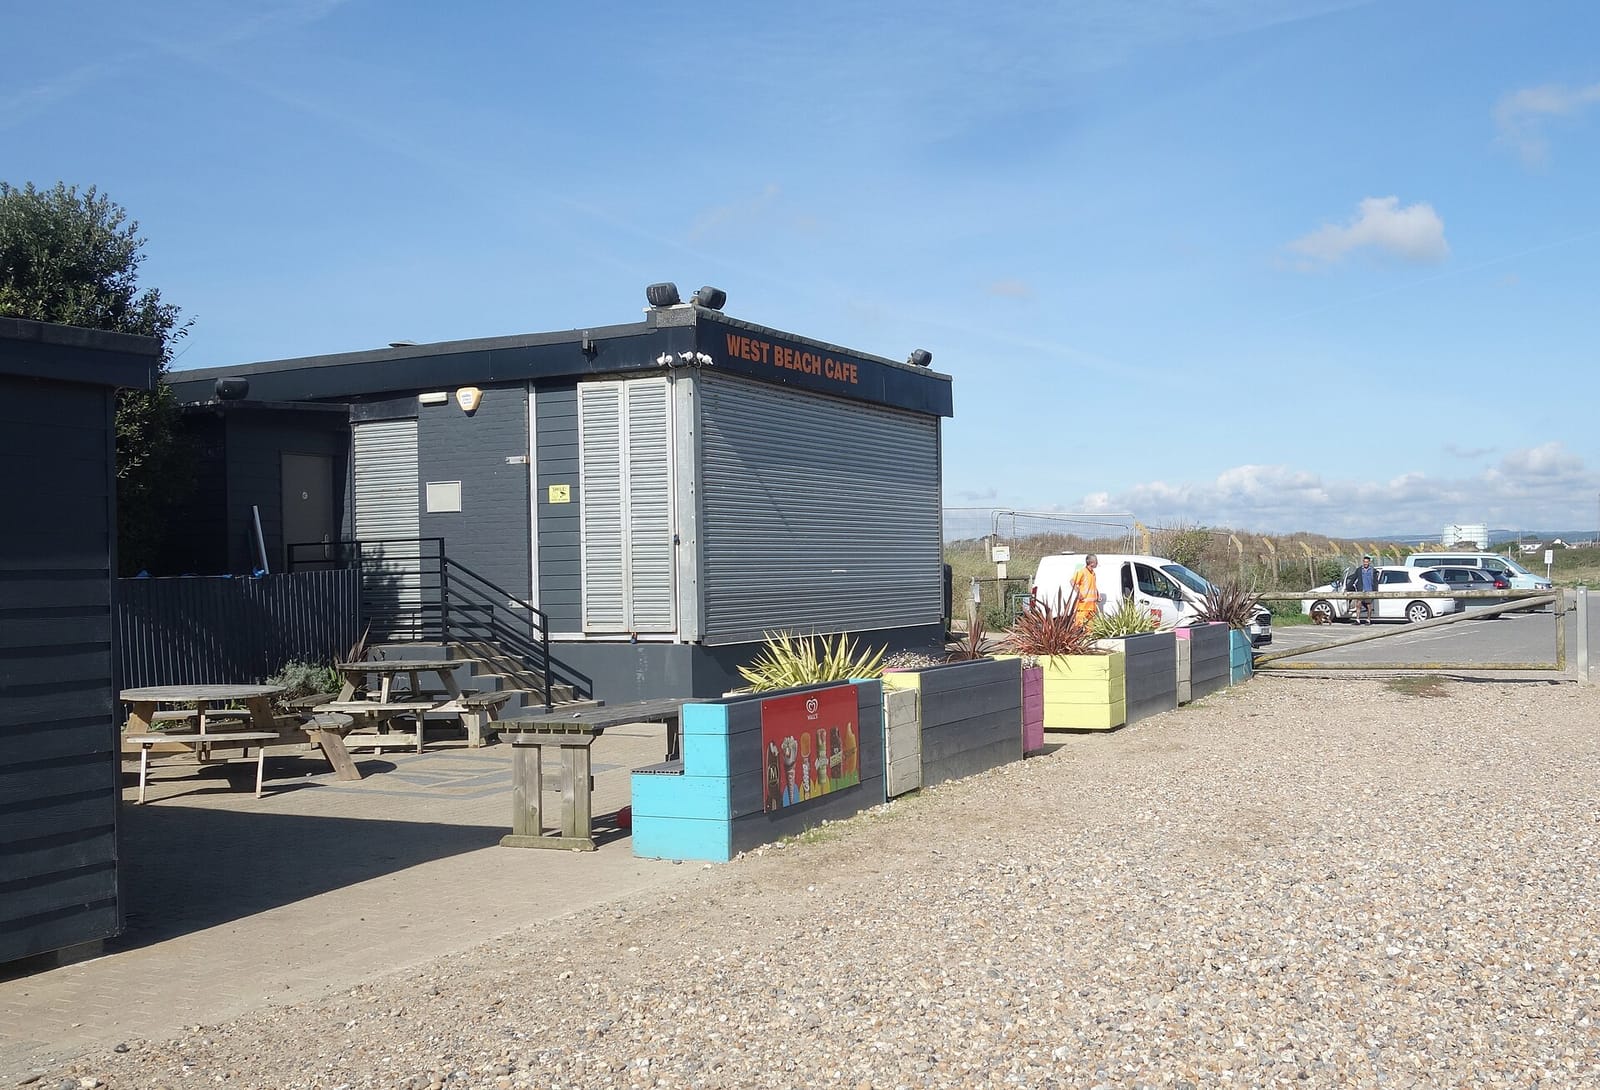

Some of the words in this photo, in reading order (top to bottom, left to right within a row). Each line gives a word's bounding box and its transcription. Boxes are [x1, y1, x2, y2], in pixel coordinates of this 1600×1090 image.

[726, 333, 770, 364] WEST
[774, 345, 822, 376] BEACH
[824, 358, 858, 385] CAFE
